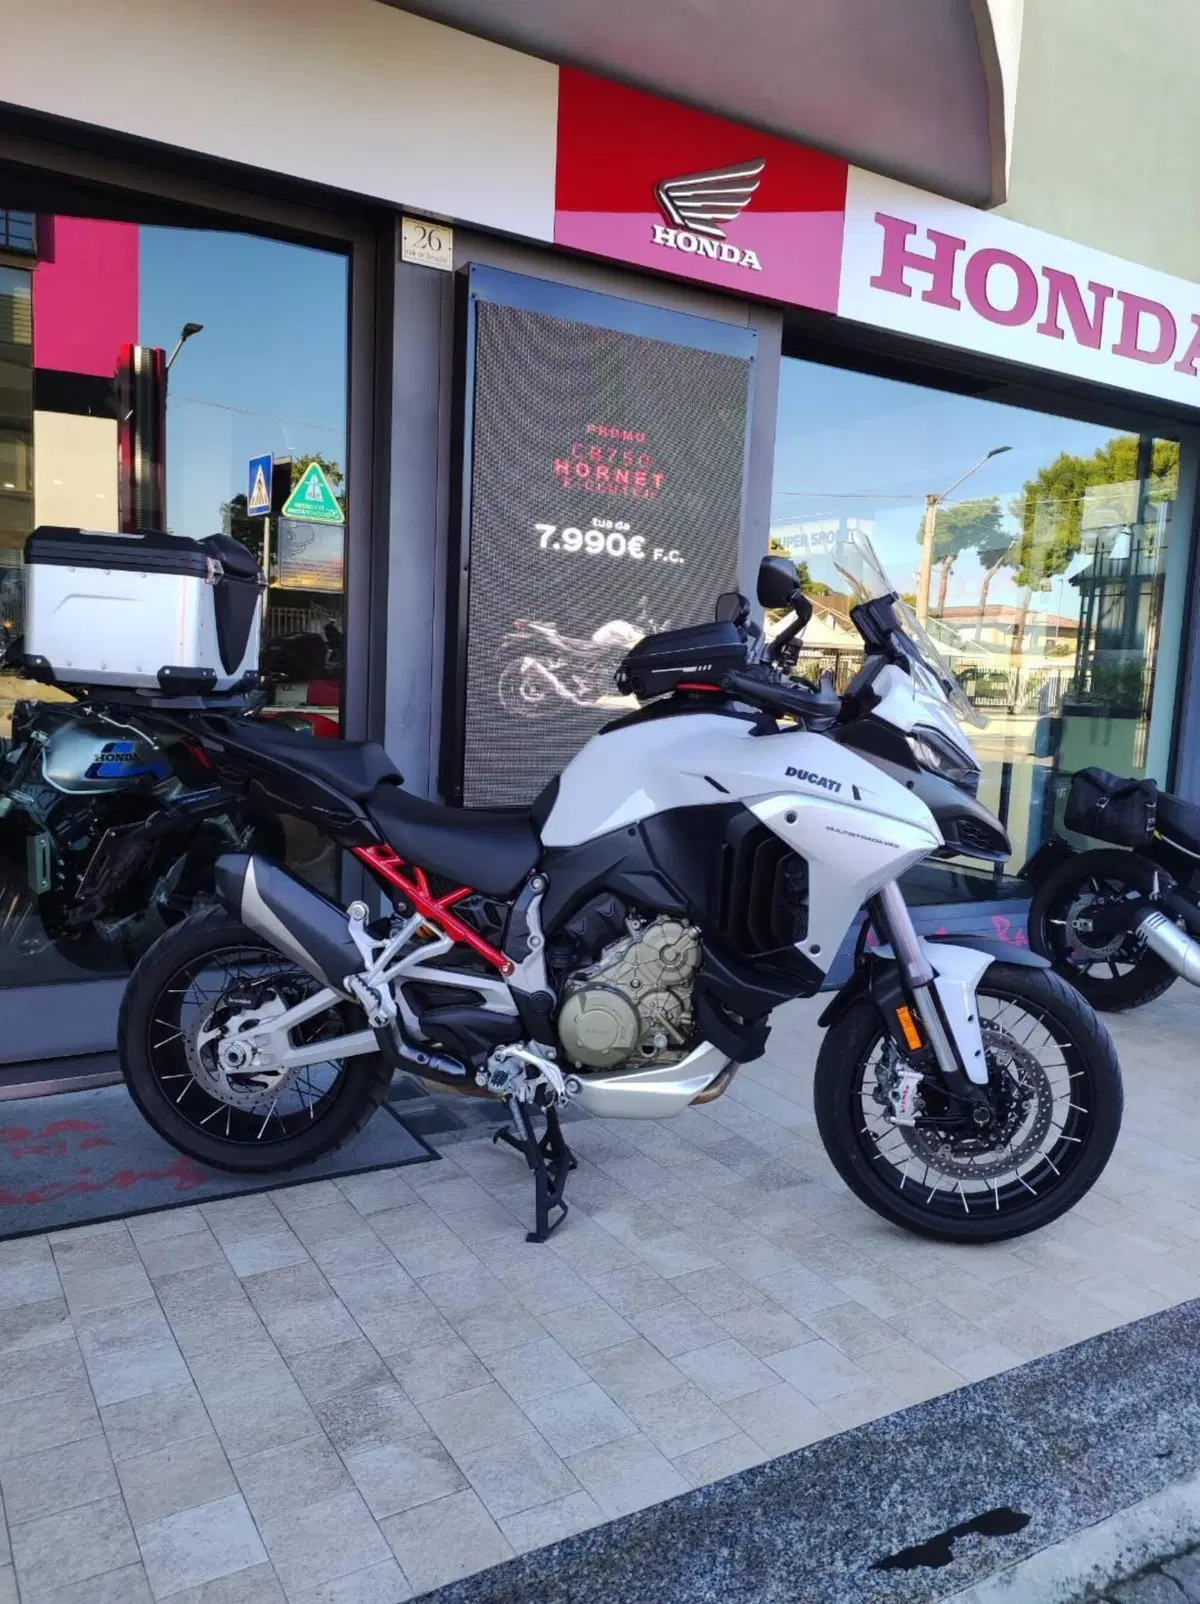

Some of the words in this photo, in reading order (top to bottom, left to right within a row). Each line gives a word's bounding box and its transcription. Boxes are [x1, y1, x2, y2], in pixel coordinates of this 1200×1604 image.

[413, 225, 442, 252] 26
[650, 224, 763, 273] HONDA
[587, 423, 646, 443] PROMO
[553, 458, 666, 488] HORNET
[591, 517, 613, 529] tua
[615, 521, 631, 531] da
[535, 523, 646, 560] 7.990€
[652, 548, 685, 564] F.C.
[771, 532, 809, 550] SUPER
[785, 766, 842, 793] DUCATI
